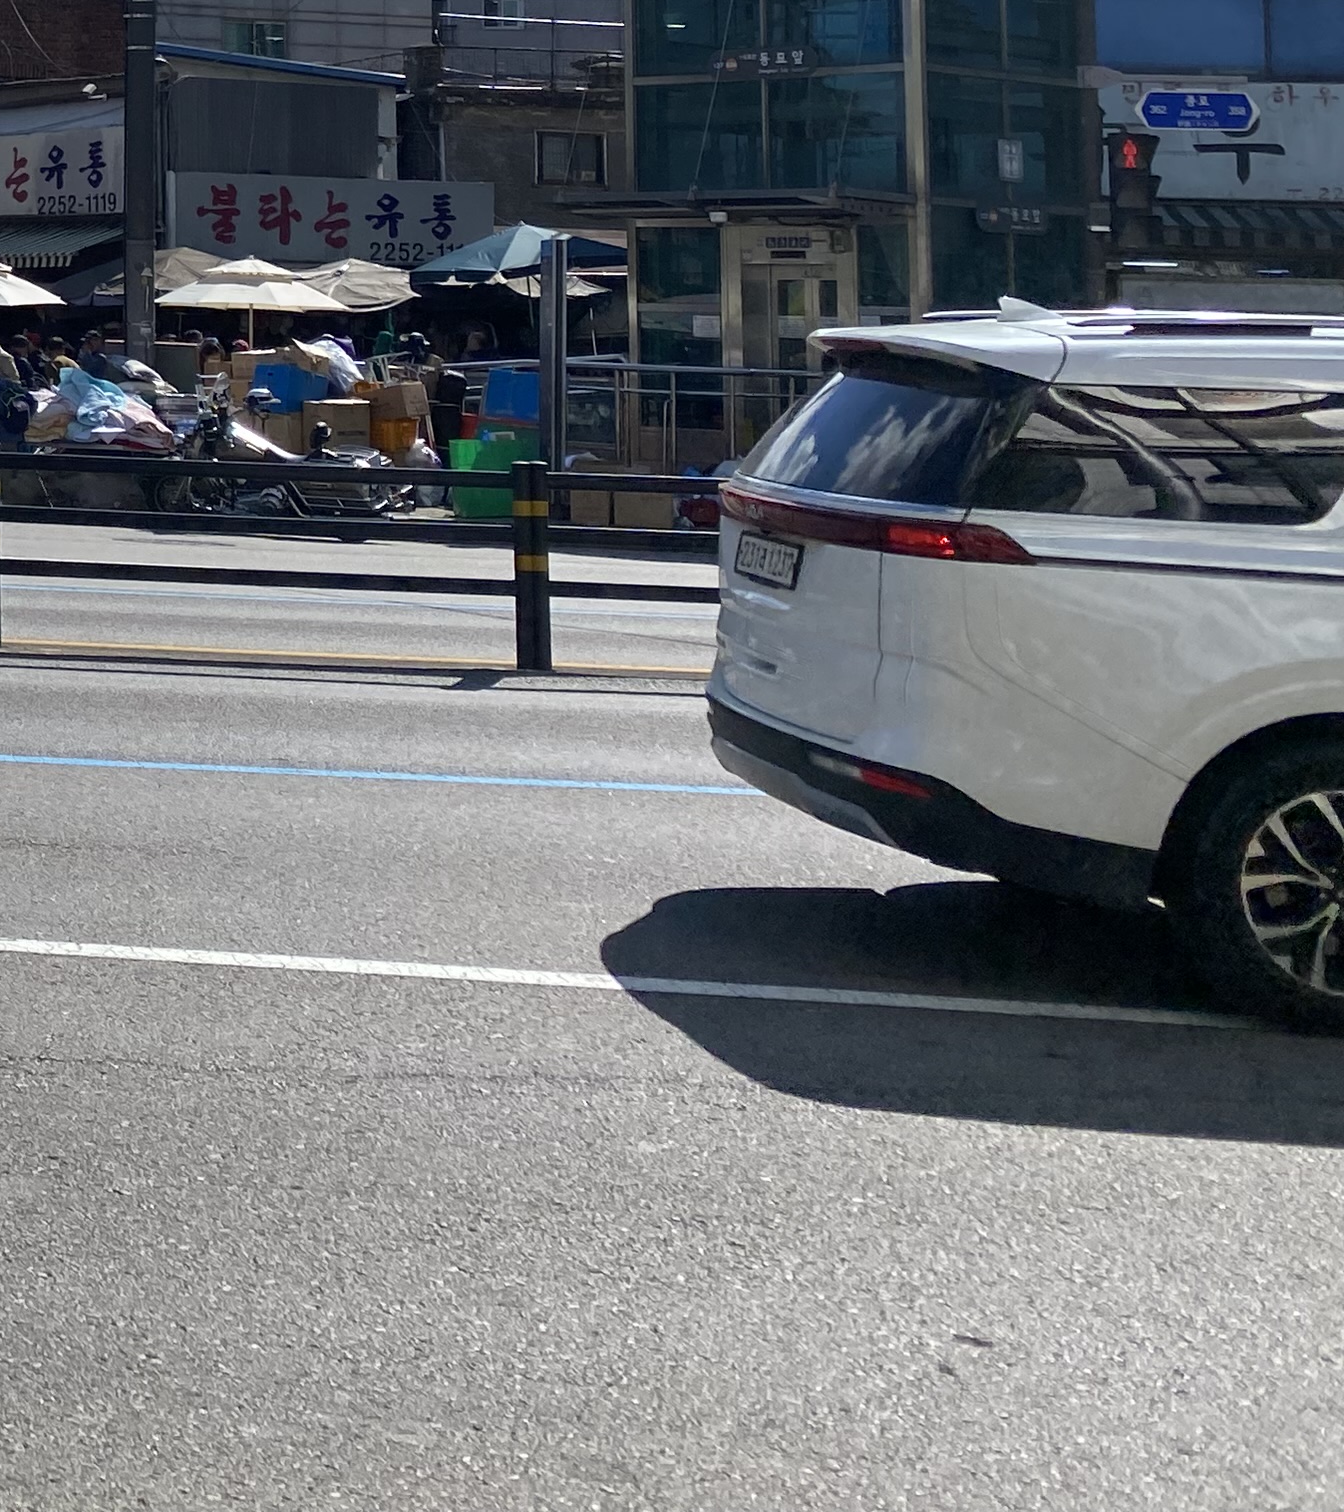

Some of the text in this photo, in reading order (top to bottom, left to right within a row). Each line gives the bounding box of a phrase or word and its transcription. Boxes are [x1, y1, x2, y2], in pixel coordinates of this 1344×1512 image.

[759, 49, 804, 68] 동묘앞
[40, 140, 107, 190] 유통
[37, 192, 117, 216] 2252-1119
[196, 183, 458, 250] 불타는 유통
